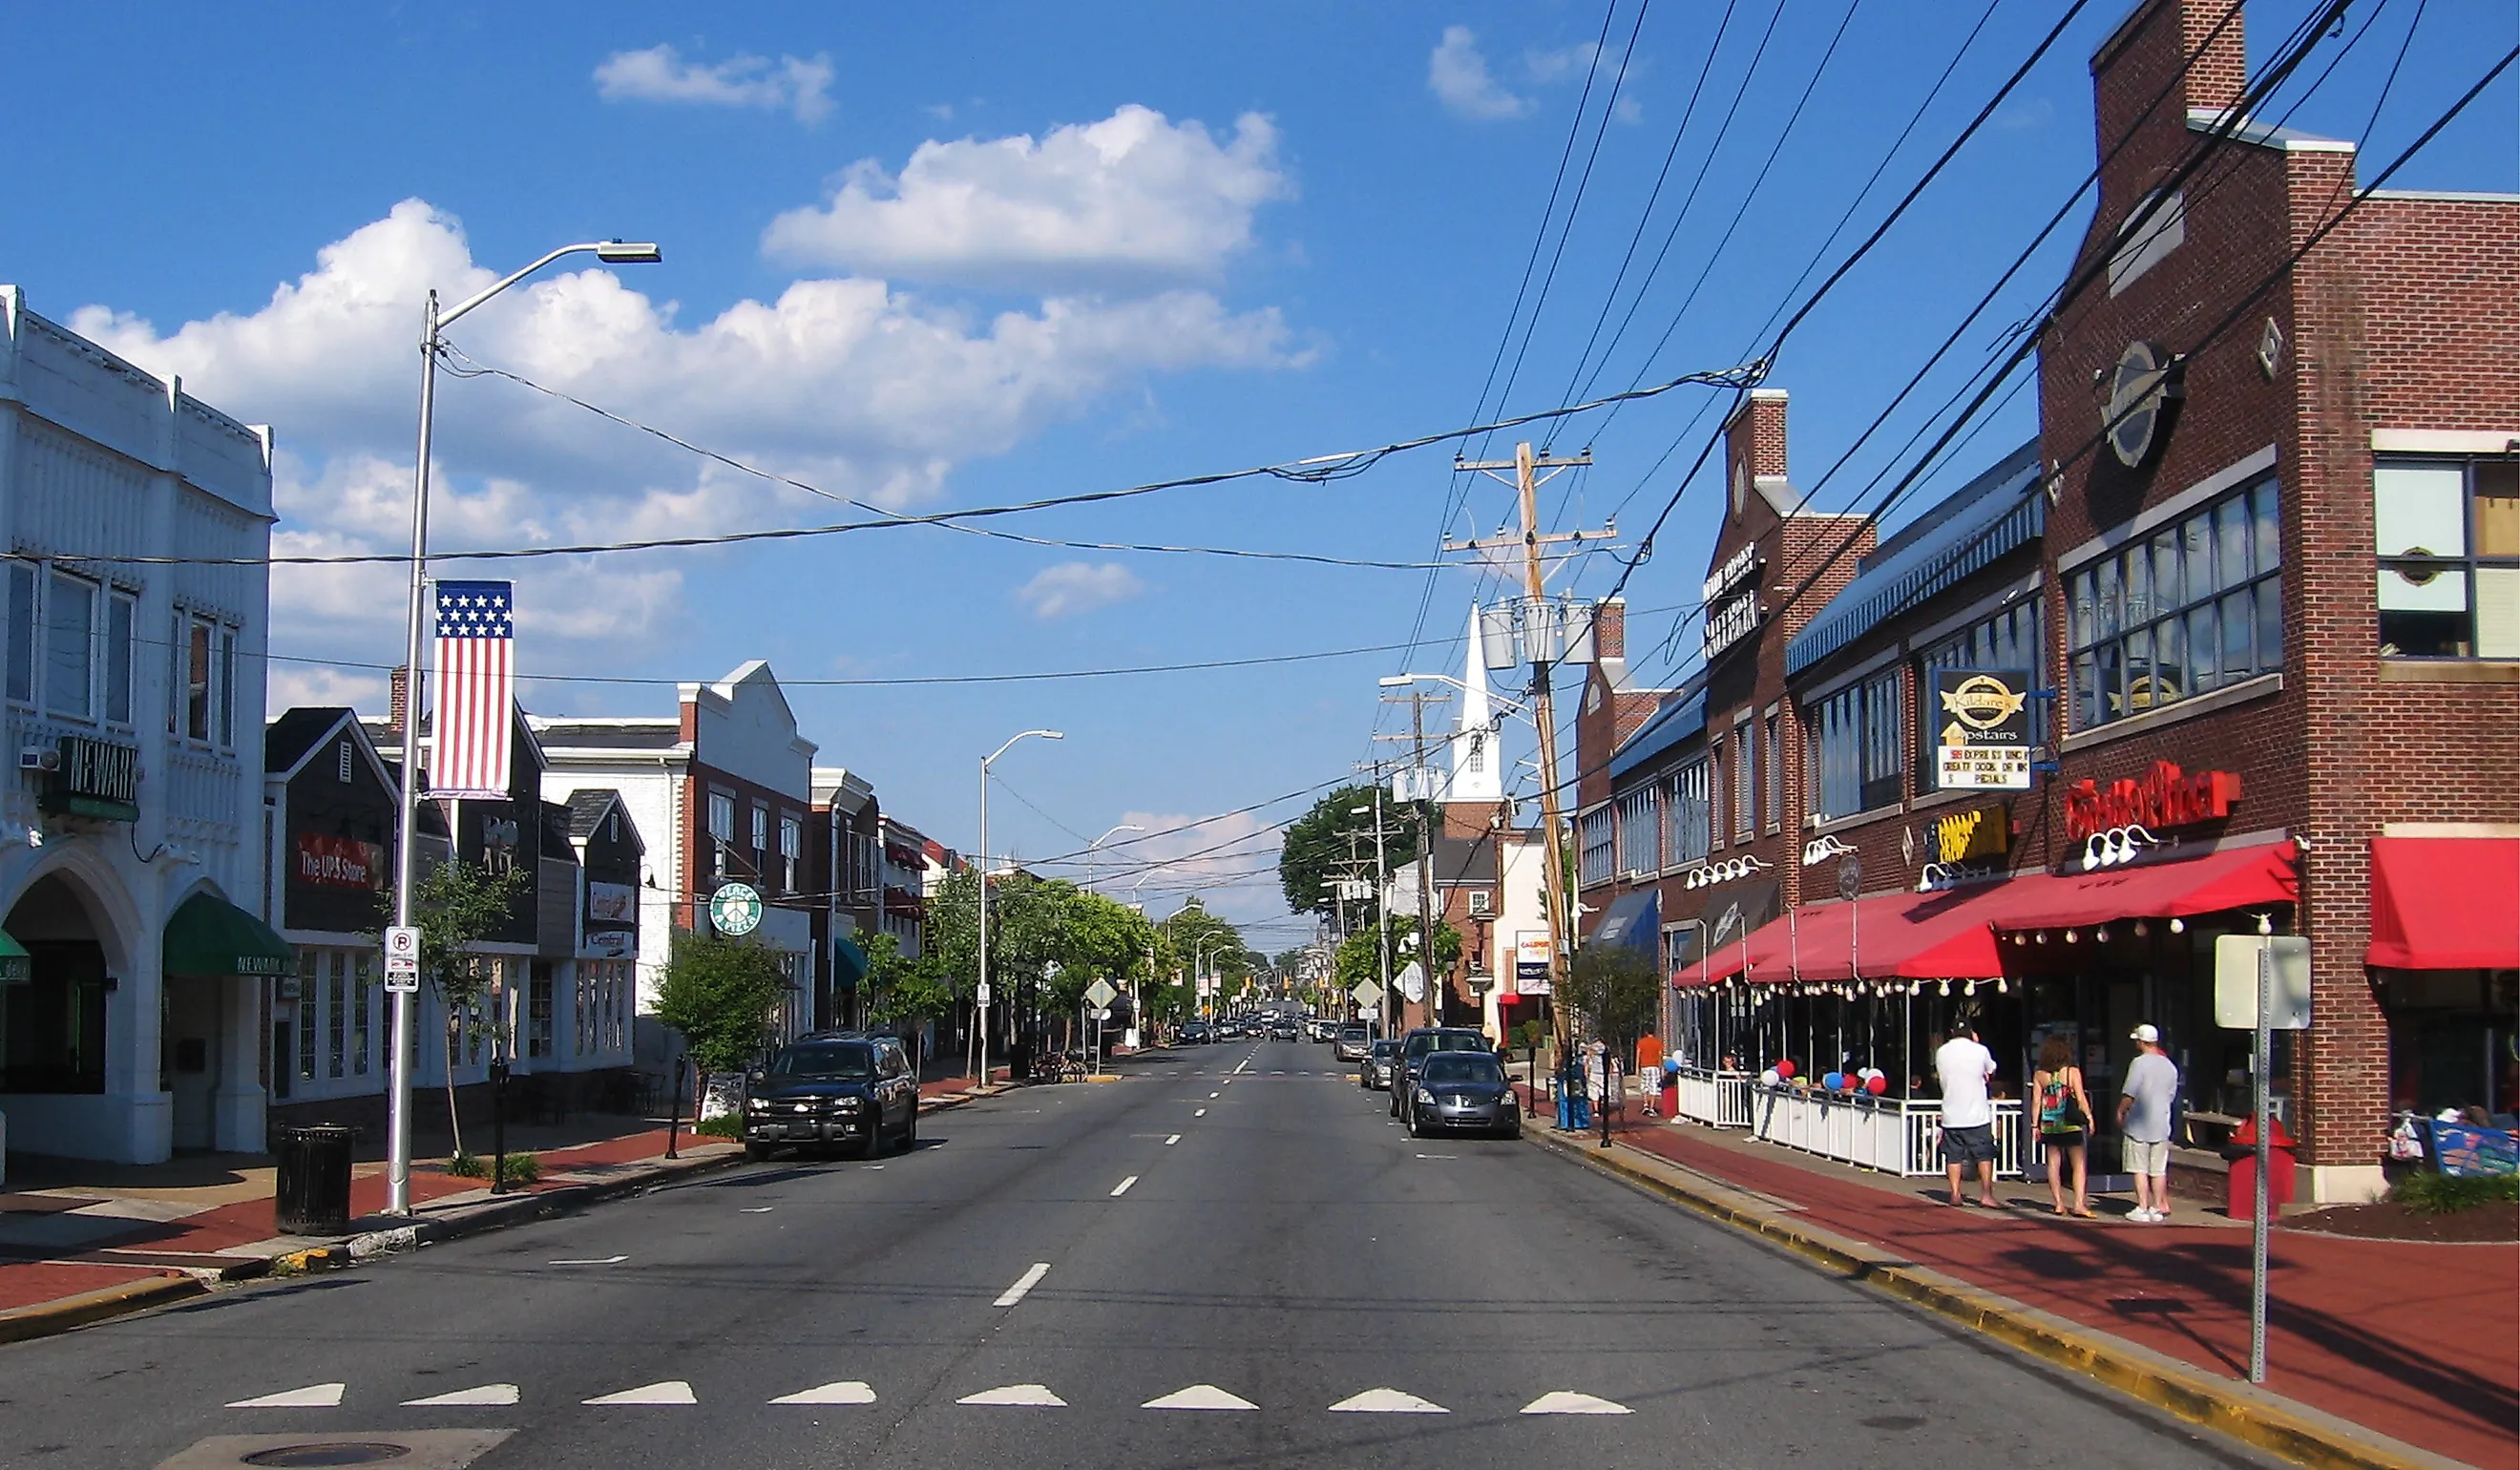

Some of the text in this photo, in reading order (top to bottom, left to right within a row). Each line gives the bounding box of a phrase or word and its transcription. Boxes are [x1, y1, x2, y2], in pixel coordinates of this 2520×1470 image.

[302, 850, 321, 876] The
[322, 855, 342, 879] UPS
[718, 886, 754, 900] PEACE
